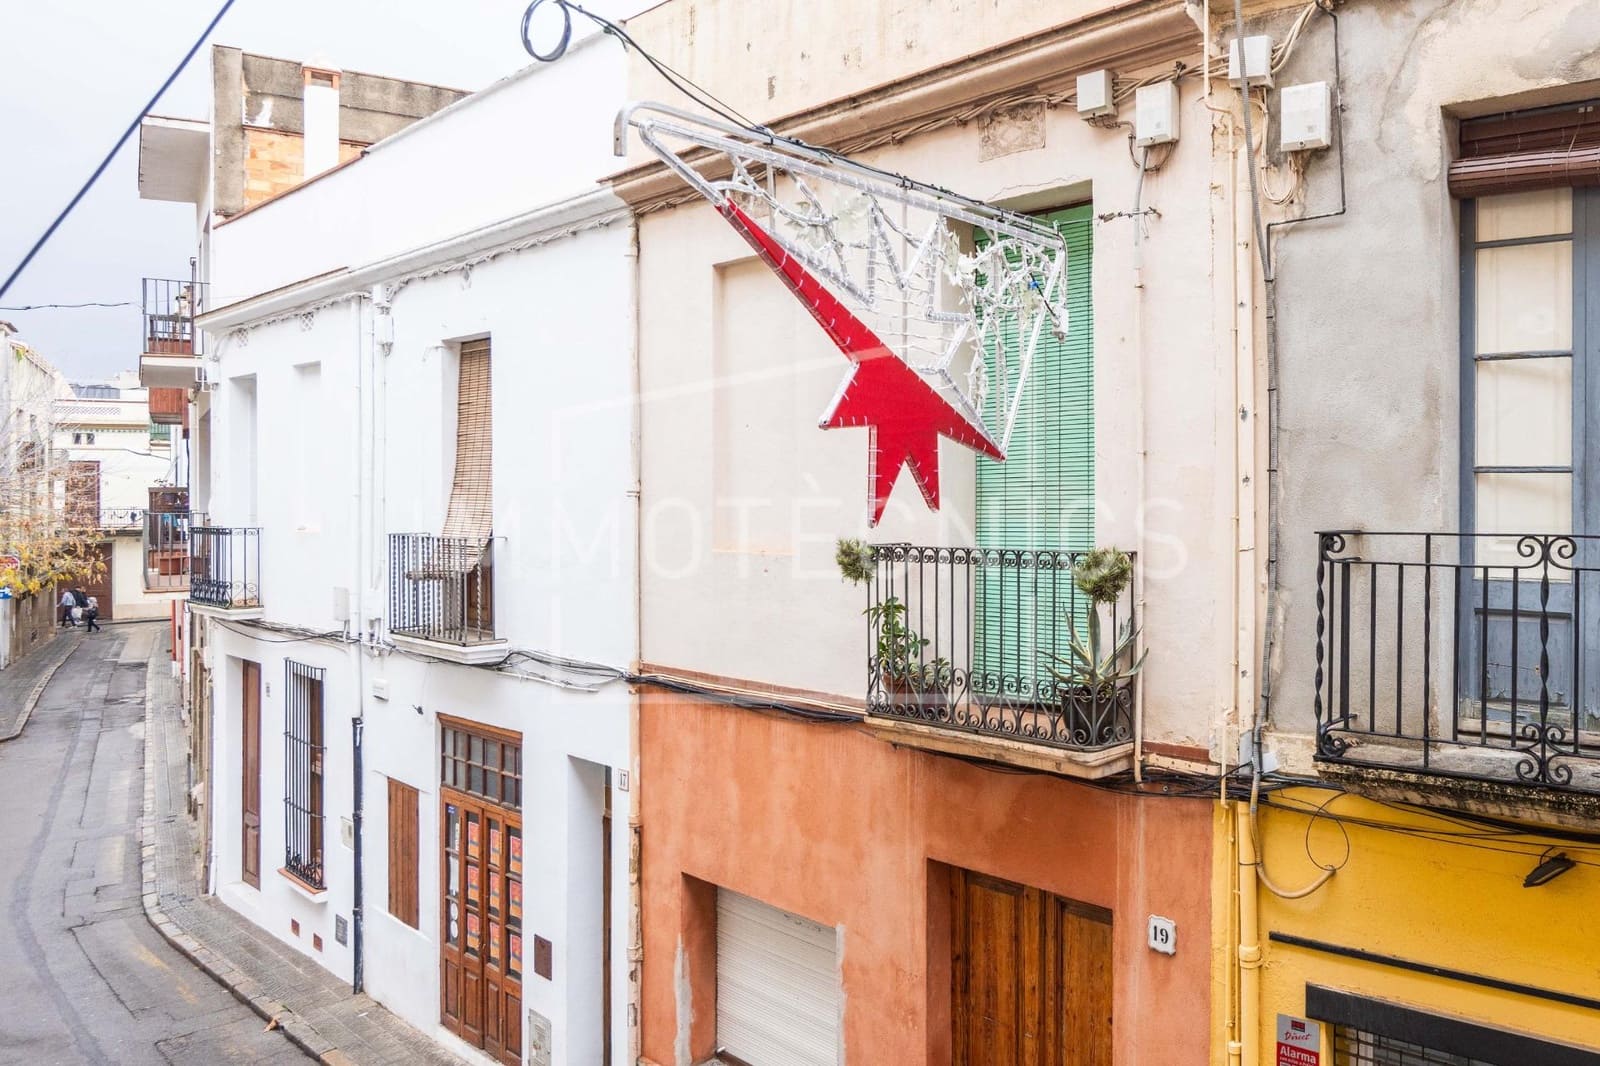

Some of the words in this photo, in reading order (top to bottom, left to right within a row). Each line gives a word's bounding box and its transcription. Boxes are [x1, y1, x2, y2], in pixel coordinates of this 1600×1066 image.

[620, 773, 627, 787] 17
[1154, 925, 1169, 944] 19
[1284, 1030, 1311, 1041] Direct
[1280, 1045, 1316, 1064] Alarma
